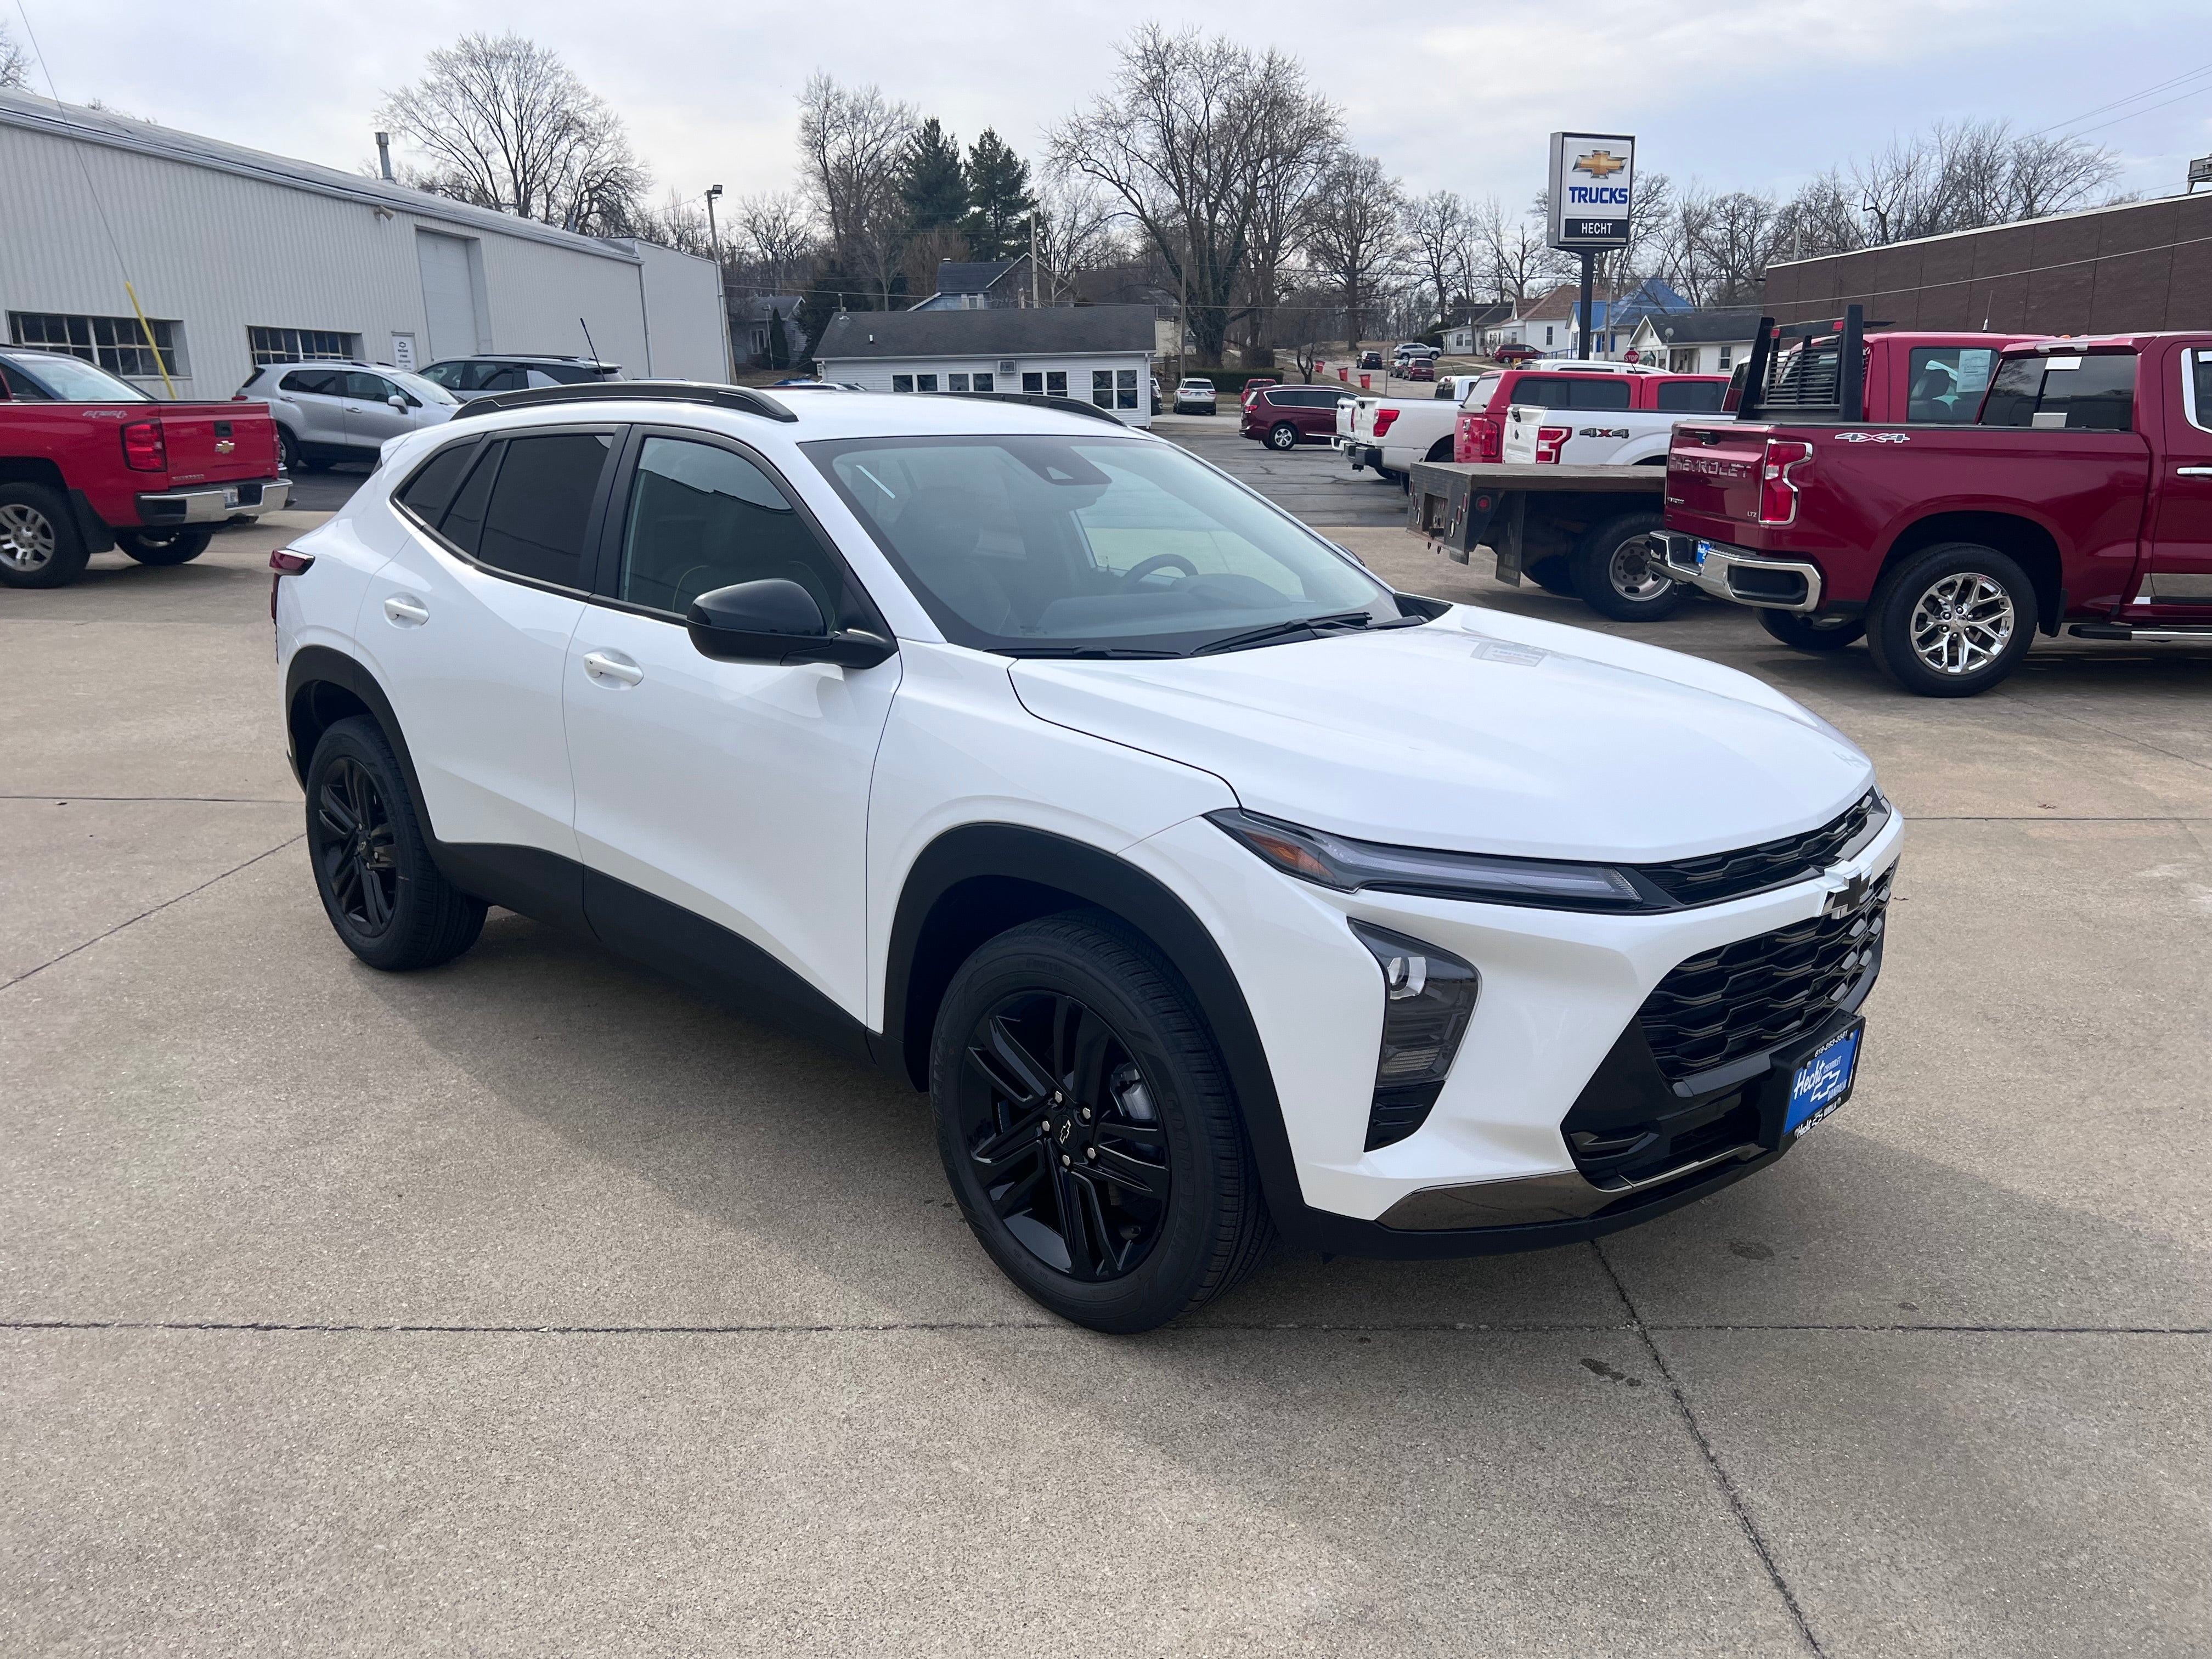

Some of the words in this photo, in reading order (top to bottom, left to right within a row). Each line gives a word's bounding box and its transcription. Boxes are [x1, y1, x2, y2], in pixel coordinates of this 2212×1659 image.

[1568, 187, 1628, 204] TRUCKS
[1581, 222, 1612, 234] HECHT
[1669, 457, 1751, 478] CHEVROLET
[1793, 1059, 1826, 1100] Hecht
